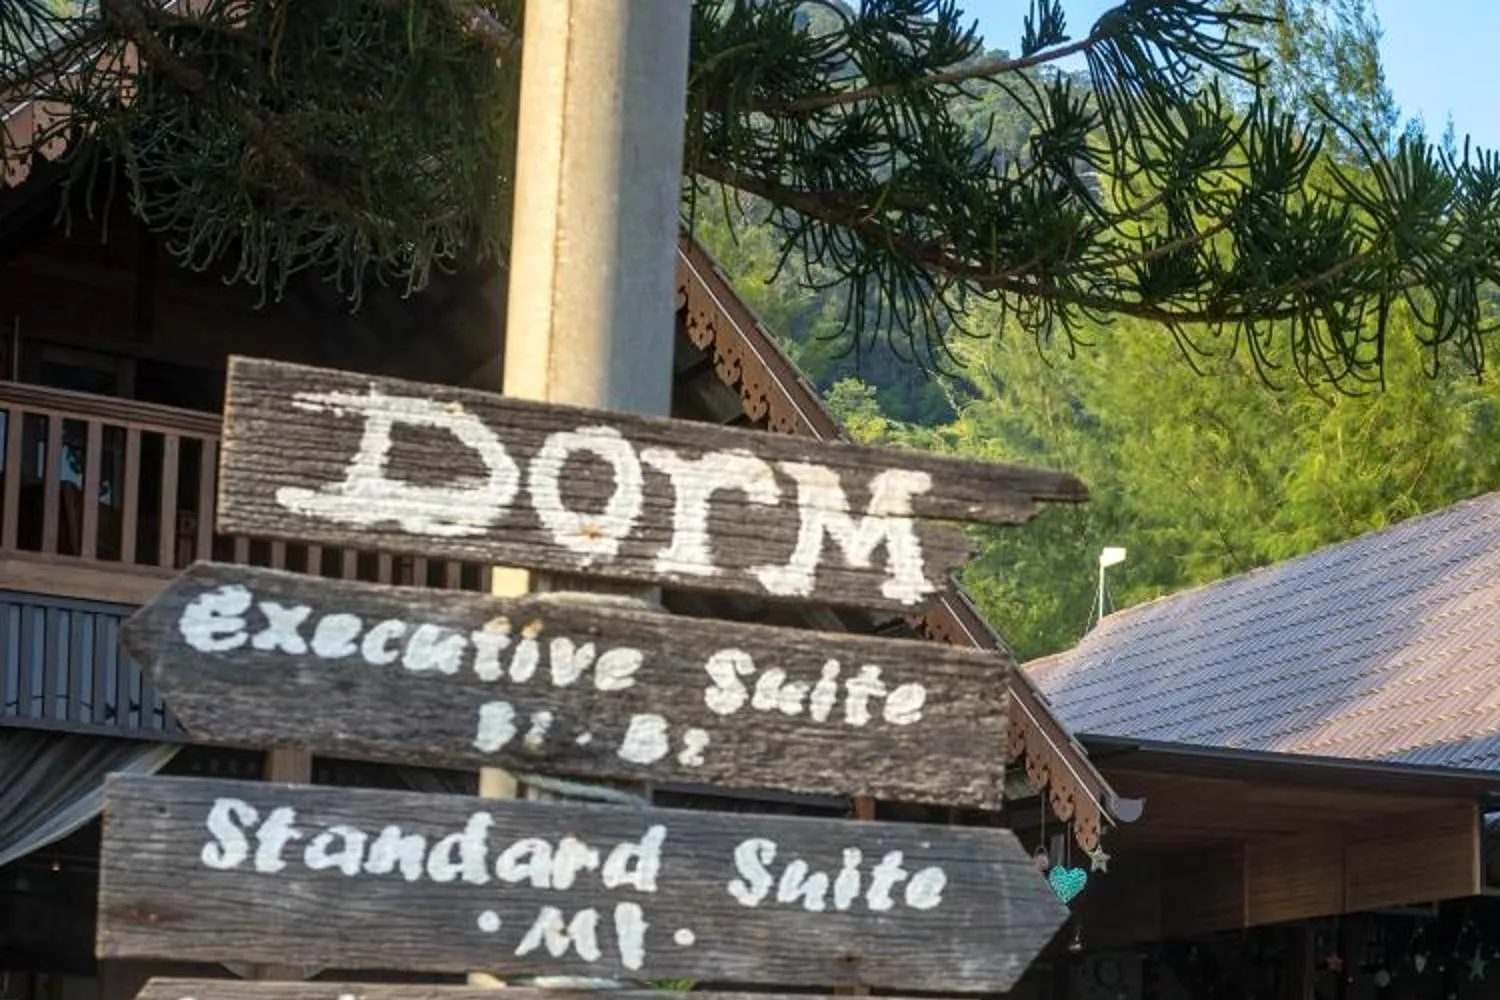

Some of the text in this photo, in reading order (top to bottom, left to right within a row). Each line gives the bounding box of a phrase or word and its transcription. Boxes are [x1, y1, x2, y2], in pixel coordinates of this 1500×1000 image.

[704, 649, 928, 727] Suite
[201, 799, 948, 912] Standard Suite
